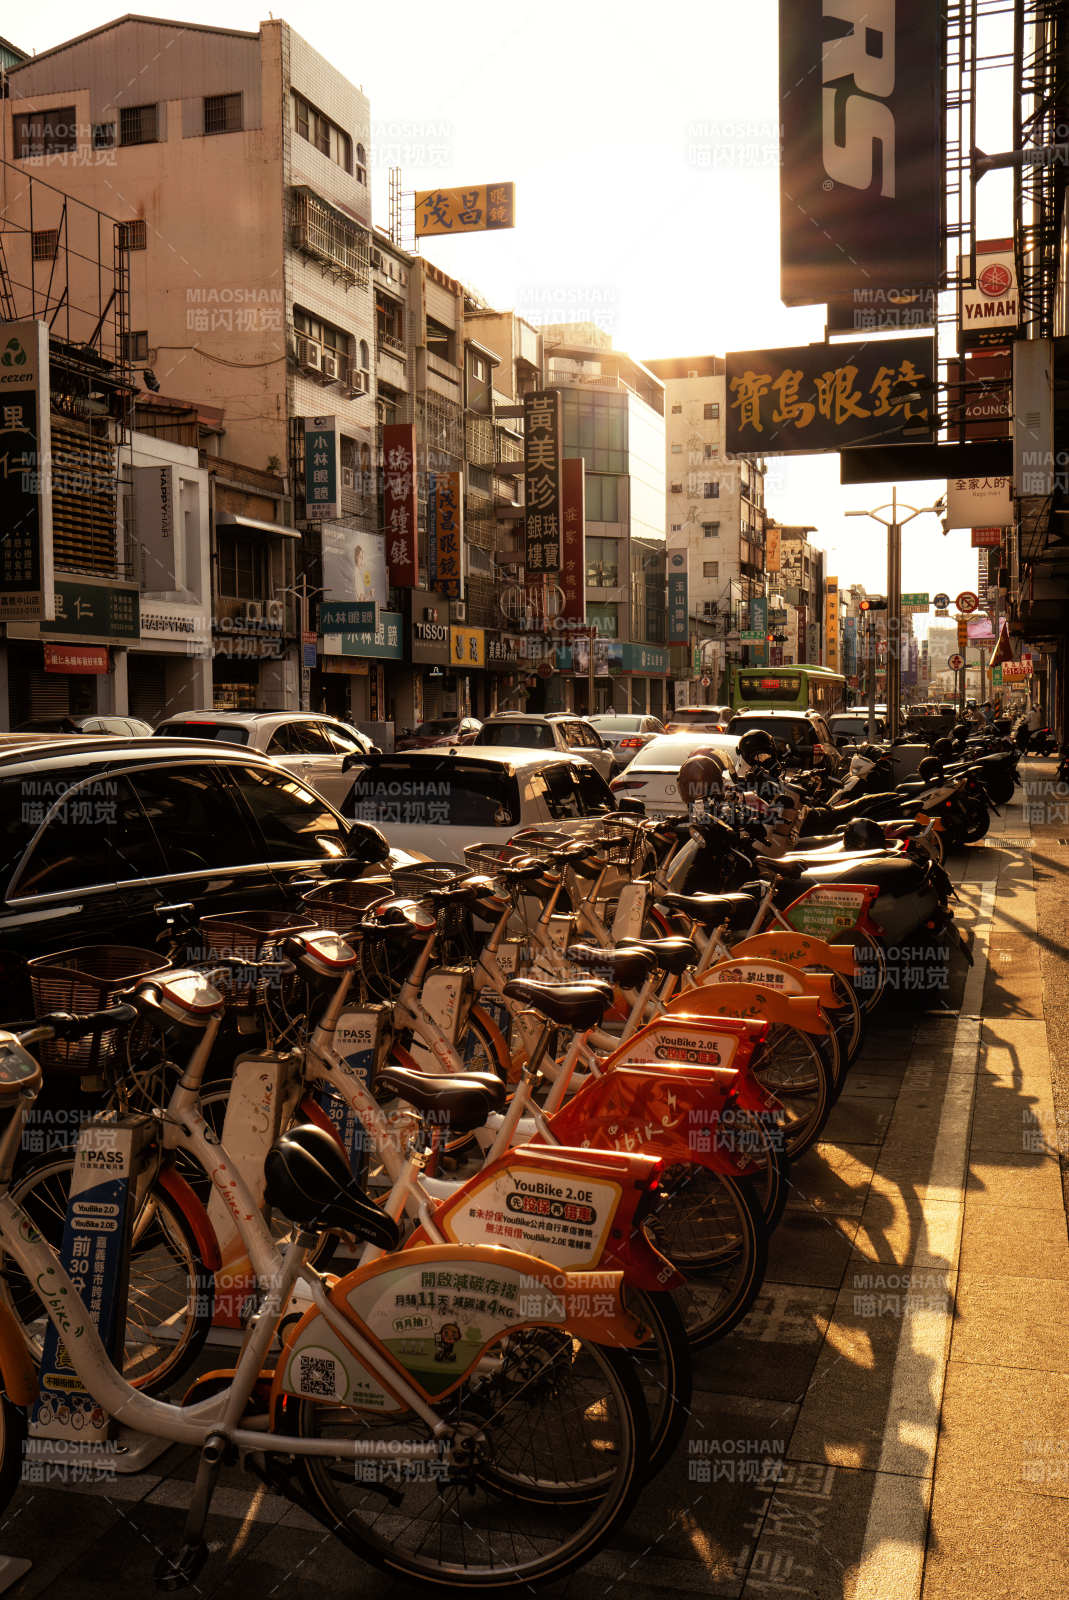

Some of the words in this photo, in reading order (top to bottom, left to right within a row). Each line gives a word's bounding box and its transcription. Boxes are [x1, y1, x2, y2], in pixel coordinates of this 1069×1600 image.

[965, 299, 1019, 320] YAMAH
[0, 372, 33, 384] eezen
[729, 359, 928, 432] 寶島眼鏡
[0, 405, 29, 480] 里仁
[526, 396, 556, 511] 黃美珍
[954, 477, 1010, 491] 全家人的
[416, 622, 449, 641] TISSOT
[337, 1029, 371, 1039] TPASS
[660, 1036, 696, 1048] YouBike
[80, 1150, 124, 1163] TPASS
[514, 1179, 563, 1198] YouBike
[566, 1187, 593, 1203] 2.0E
